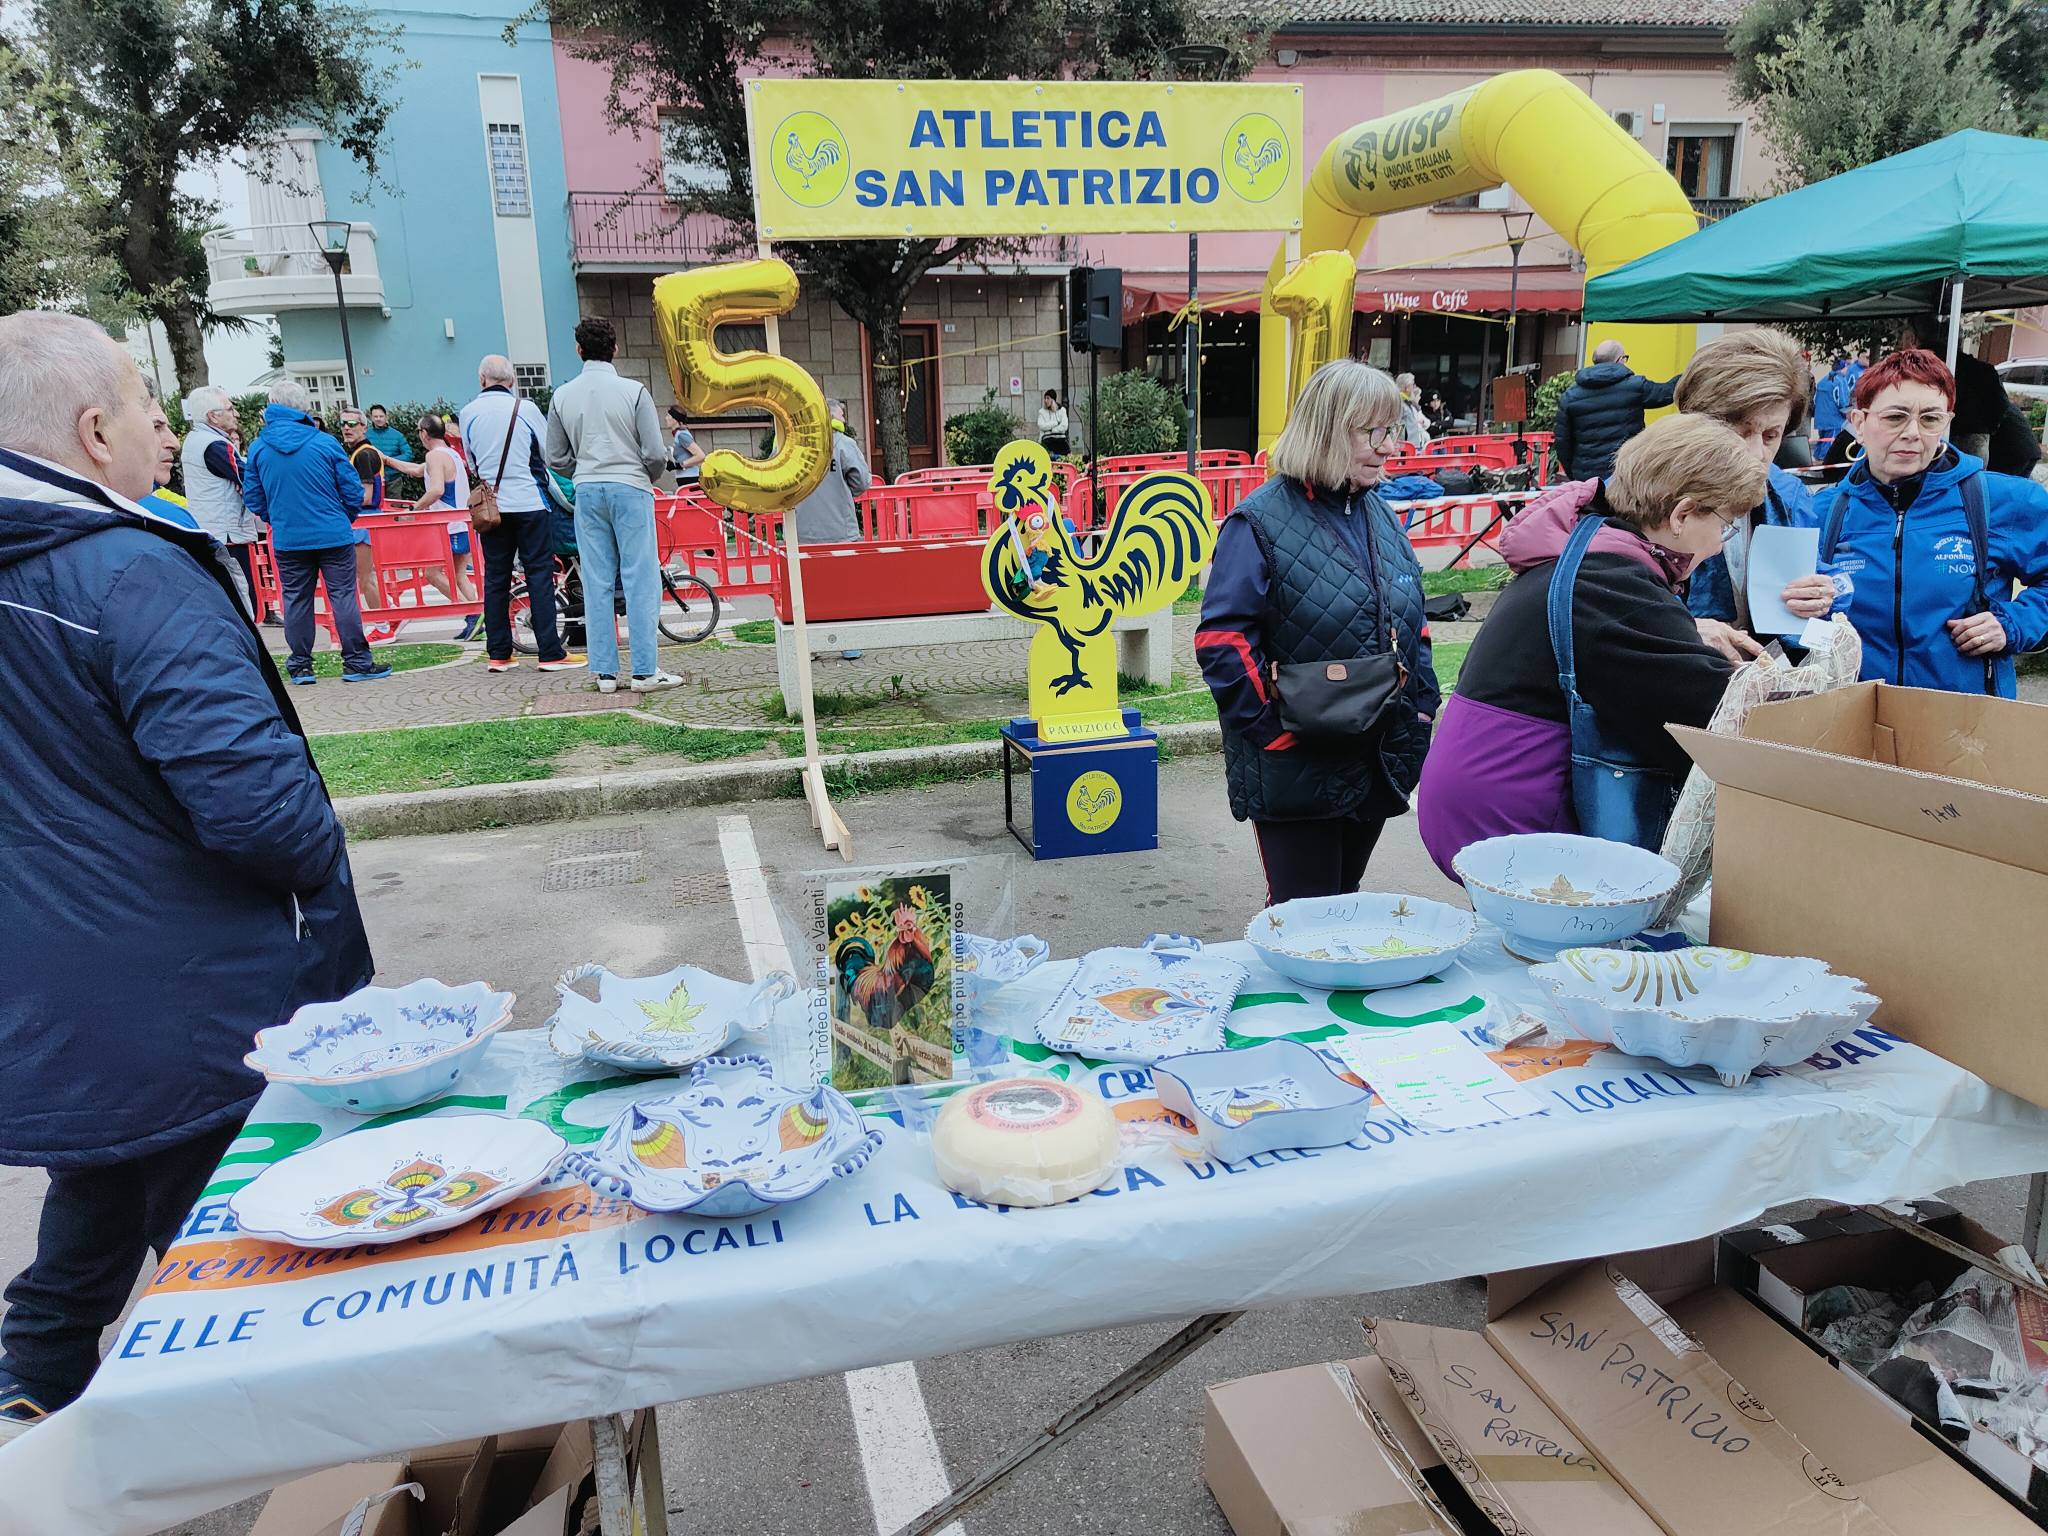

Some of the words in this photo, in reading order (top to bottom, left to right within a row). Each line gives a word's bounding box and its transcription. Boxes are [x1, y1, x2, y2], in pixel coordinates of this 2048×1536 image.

[908, 109, 1168, 149] ATLETICA
[1382, 104, 1454, 161] UISP
[1383, 160, 1414, 178] UNIONE
[1415, 149, 1453, 171] ITALIANA
[1389, 177, 1415, 191] SPORT
[1415, 172, 1432, 184] PER
[1431, 166, 1455, 180] TUTTI
[854, 170, 965, 207] SAN
[985, 167, 1220, 206] PATRIZIO
[1383, 291, 1420, 312] Wine
[652, 257, 833, 514] 5
[816, 942, 826, 952] e
[953, 902, 965, 972] numeroso
[813, 957, 828, 1008] Buriani
[951, 977, 968, 1001] più
[814, 1011, 830, 1060] Trofeo
[953, 1004, 968, 1055] Gruppo
[1551, 1071, 1699, 1114] LOCALI
[863, 1192, 921, 1226] LA
[302, 1243, 580, 1327] COMUNITÀ
[618, 1219, 785, 1275] LOCALI
[1529, 1311, 1606, 1353] SAN
[1443, 1364, 1517, 1414] SAN
[1813, 1475, 1830, 1488] IT
